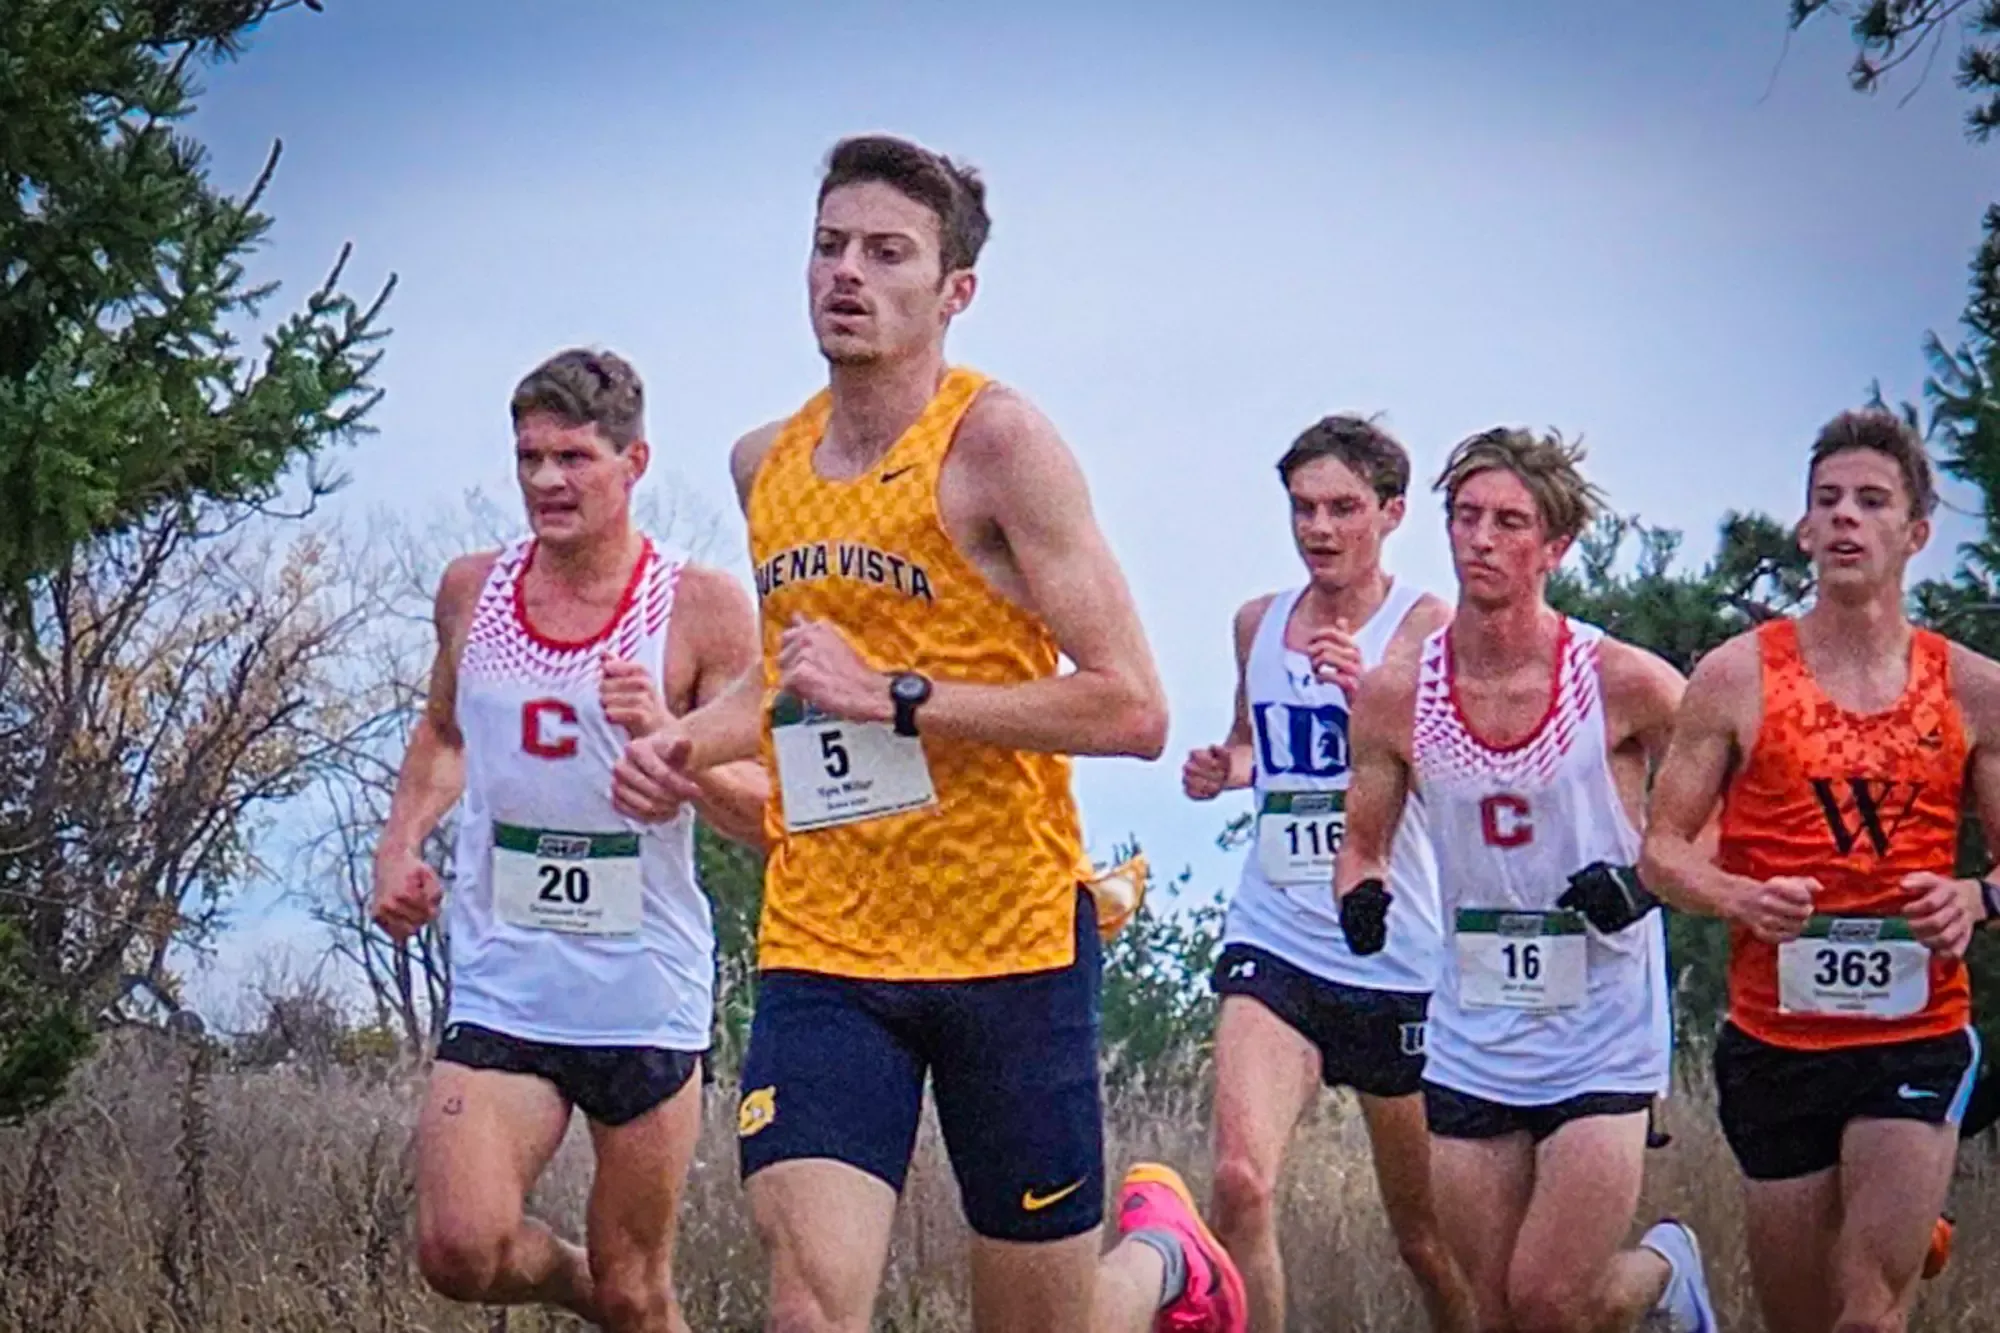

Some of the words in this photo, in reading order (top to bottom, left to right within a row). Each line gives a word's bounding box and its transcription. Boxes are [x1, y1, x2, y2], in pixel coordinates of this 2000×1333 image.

[756, 544, 828, 596] UENA
[839, 544, 934, 607] VISTA
[522, 698, 578, 758] C
[818, 729, 850, 779] 5
[1285, 821, 1345, 855] 116
[1480, 793, 1533, 849] C
[1807, 777, 1926, 857] W
[537, 864, 590, 904] 20
[1502, 943, 1540, 980] 16
[1814, 949, 1892, 988] 363
